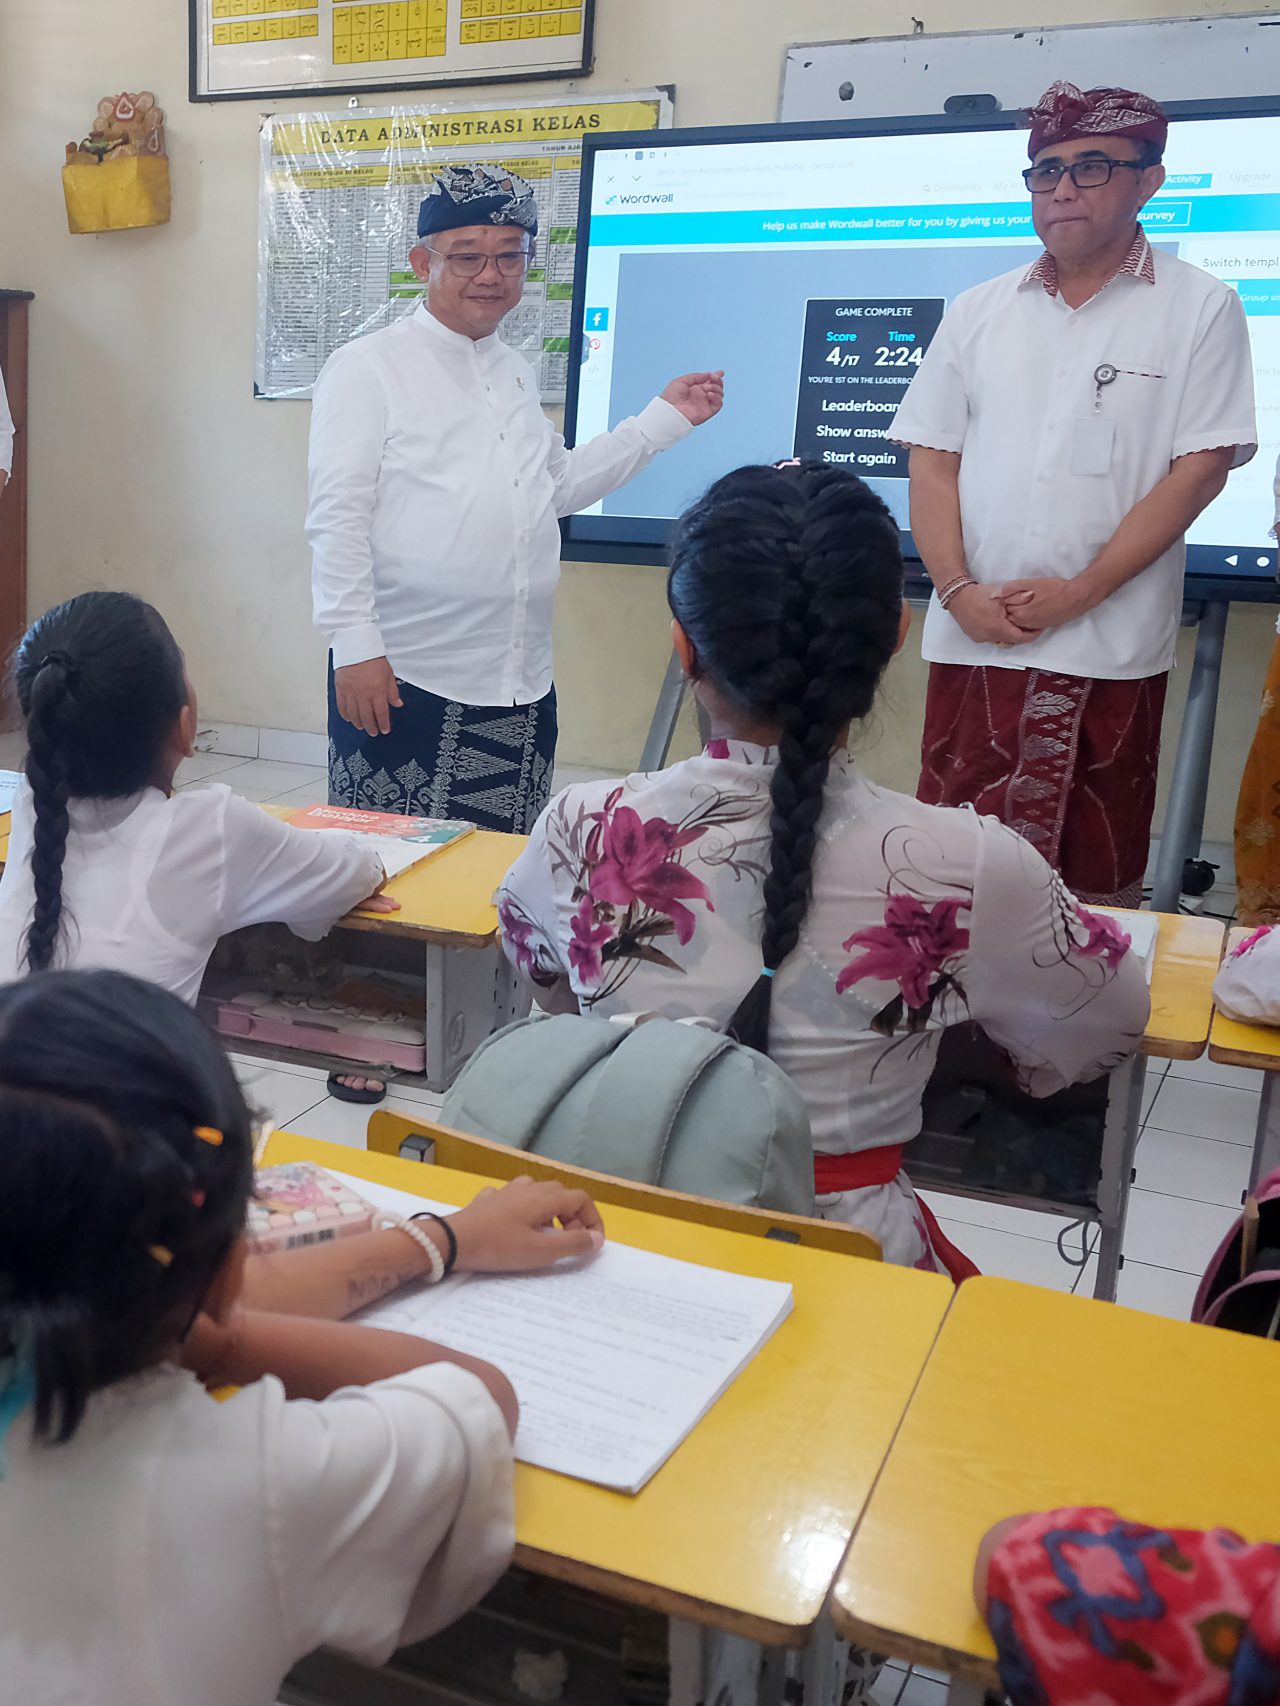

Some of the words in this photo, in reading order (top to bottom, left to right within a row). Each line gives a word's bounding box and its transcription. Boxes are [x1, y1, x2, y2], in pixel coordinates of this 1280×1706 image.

[321, 127, 369, 144] DATA
[533, 113, 601, 132] KELAS
[1167, 176, 1202, 184] Activity
[1230, 172, 1272, 182] Upgrade
[620, 194, 674, 205] Wordwall
[1136, 212, 1175, 222] survey
[763, 221, 785, 232] Help
[786, 222, 798, 231] us
[800, 220, 826, 230] make
[828, 218, 874, 229] Wordwall
[875, 217, 905, 228] better
[908, 217, 922, 227] for
[924, 218, 944, 229] you
[945, 216, 959, 228] by
[959, 215, 991, 228] giving
[993, 215, 1005, 225] us
[1007, 215, 1032, 226] your
[1203, 257, 1242, 267] Switch
[1246, 256, 1279, 268] templ
[1240, 294, 1270, 303] Group
[836, 308, 863, 316] GAME
[864, 307, 913, 316] COMPLETE
[826, 331, 857, 341] Score
[888, 331, 916, 341] Time
[825, 346, 860, 367] 4/17
[874, 347, 923, 366] 2:24
[808, 376, 834, 384] YOU'RE
[835, 376, 846, 384] 1ST
[847, 376, 860, 384] ON
[861, 376, 874, 384] THE
[875, 377, 913, 385] LEADERBO
[822, 400, 900, 413] Leaderboar
[816, 425, 852, 438] Show
[854, 427, 889, 438] answ
[823, 451, 855, 463] Start
[858, 453, 896, 466] again
